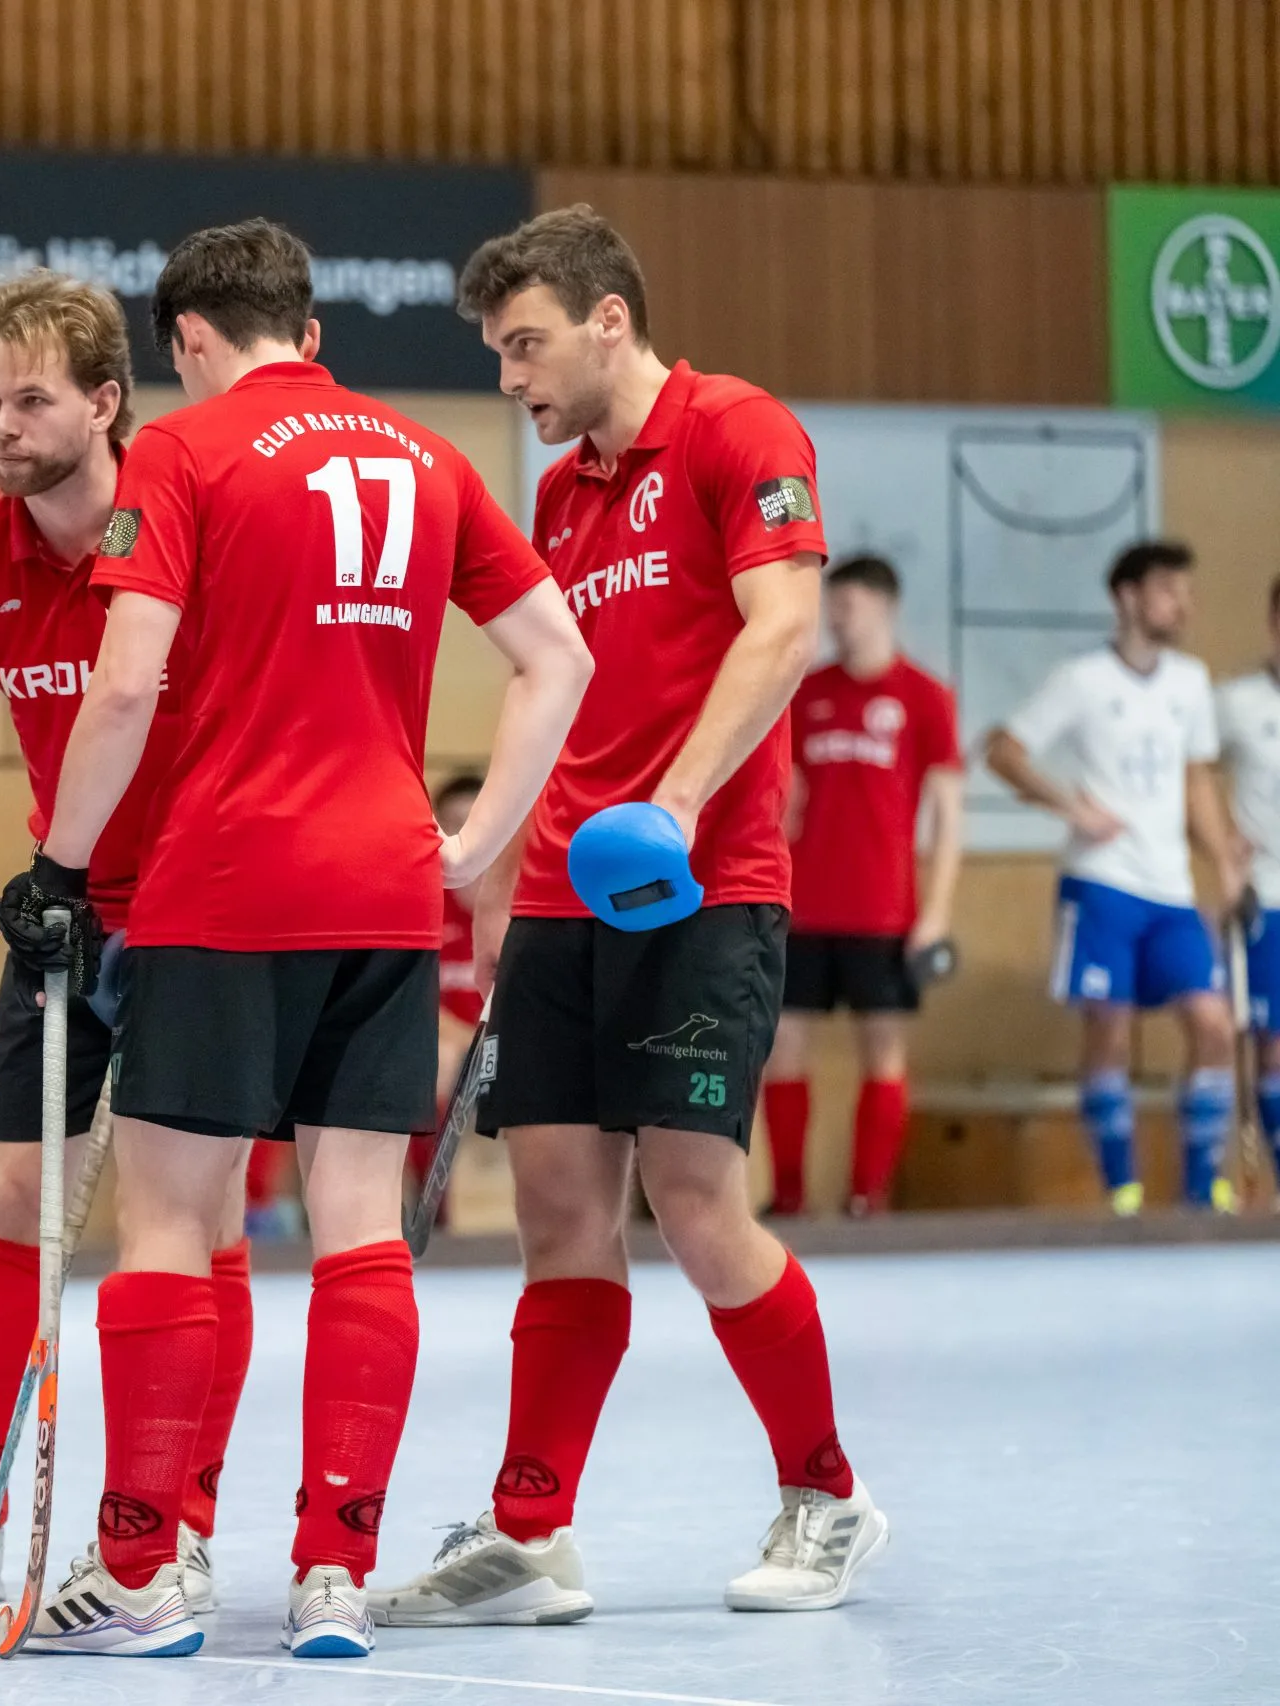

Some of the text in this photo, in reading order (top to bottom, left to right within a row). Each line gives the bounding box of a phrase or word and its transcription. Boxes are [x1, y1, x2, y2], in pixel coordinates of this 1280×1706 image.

[252, 413, 434, 469] CLUB RAFFELBERG
[306, 456, 416, 589] 17
[341, 574, 355, 583] CR
[382, 575, 398, 585] CR
[317, 604, 336, 624] M.
[646, 1042, 728, 1061] hundgehrecht
[689, 1072, 726, 1106] 25
